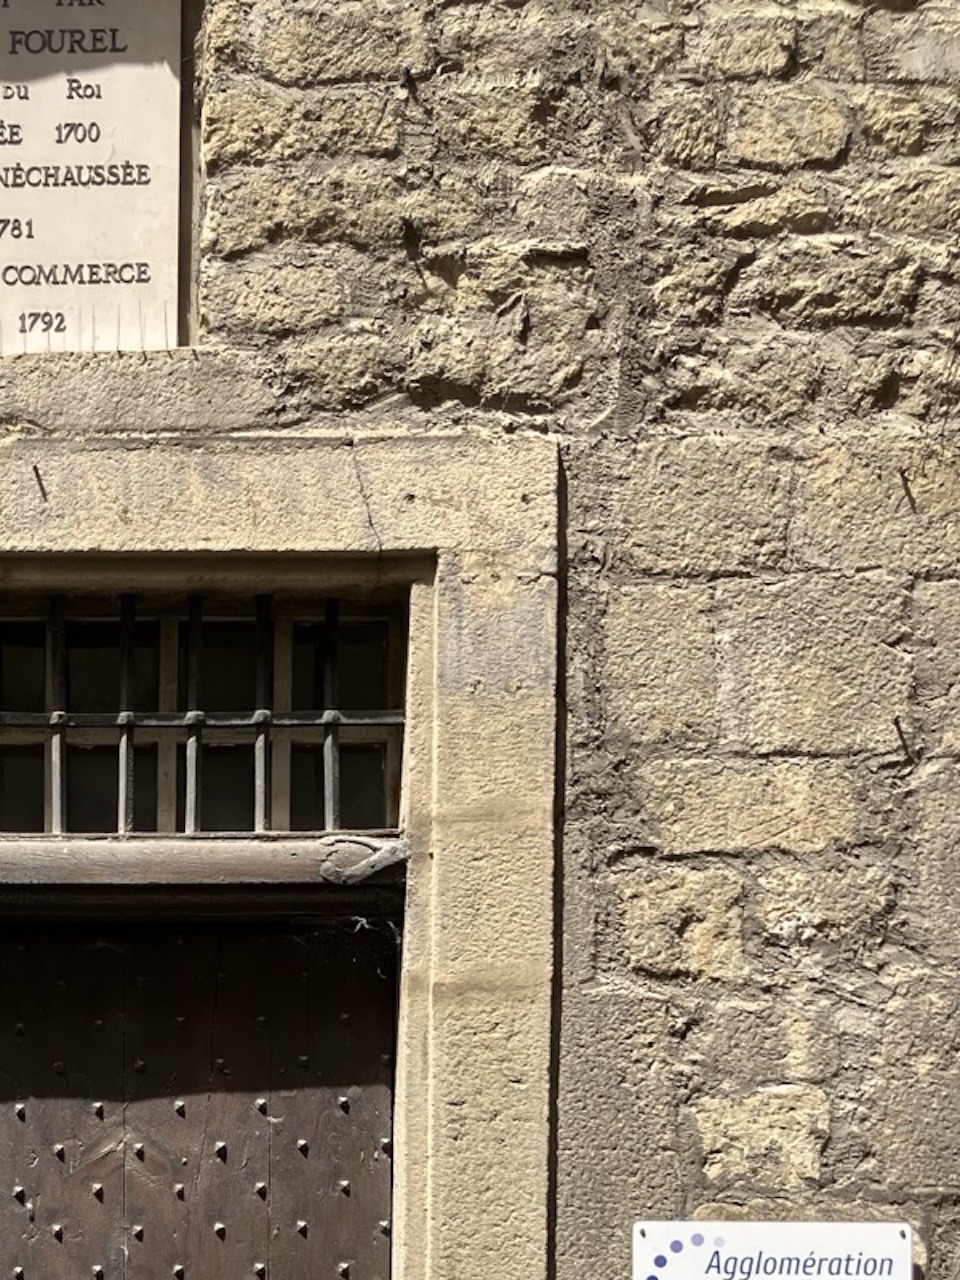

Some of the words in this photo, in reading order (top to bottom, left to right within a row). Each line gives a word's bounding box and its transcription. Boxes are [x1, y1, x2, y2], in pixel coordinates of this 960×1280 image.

[8, 28, 128, 55] FOUREL
[55, 122, 101, 144] 1700
[1, 262, 151, 285] COMMERCE
[19, 312, 66, 333] 1792
[705, 1251, 894, 1280] Agglomération
